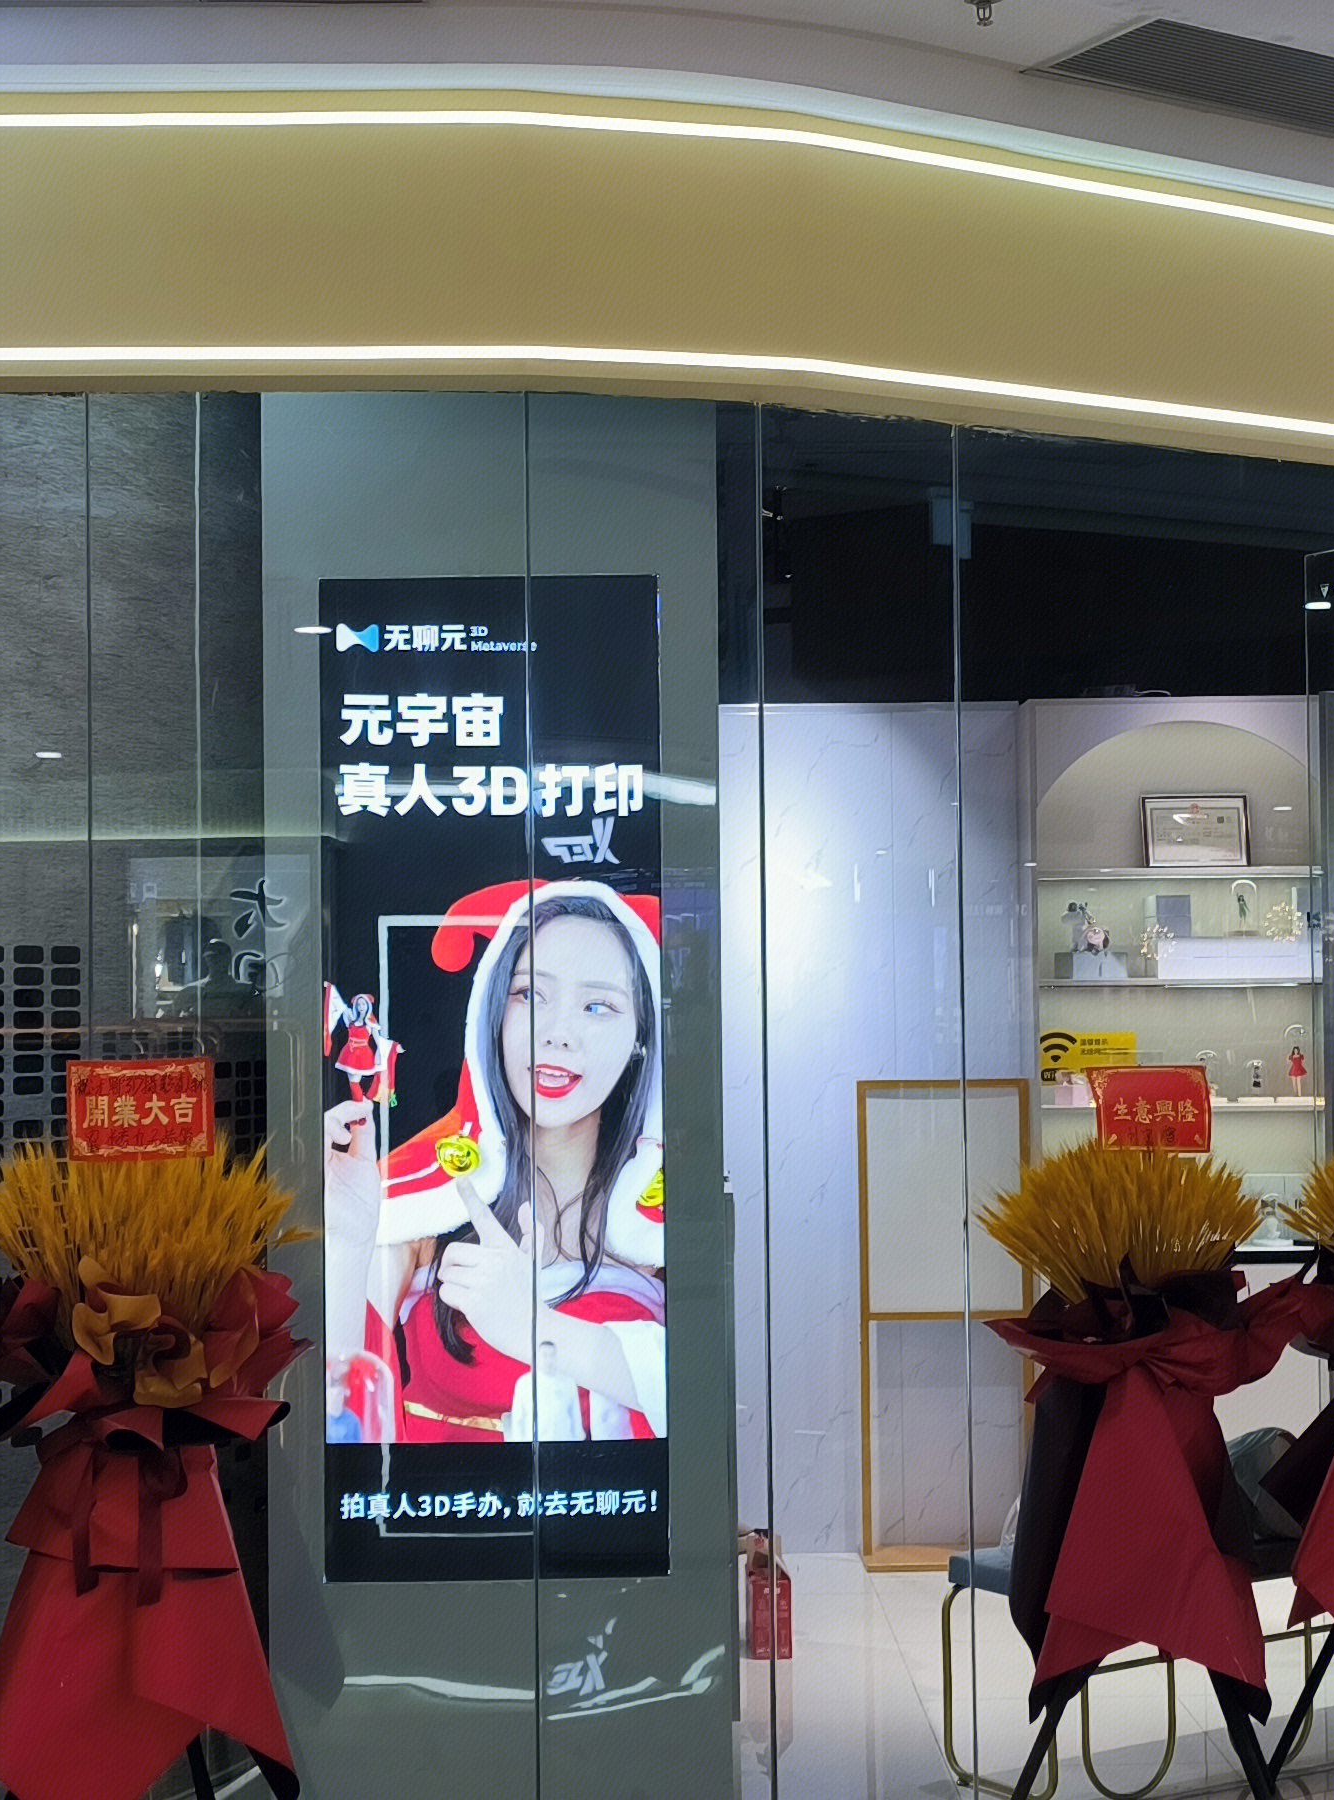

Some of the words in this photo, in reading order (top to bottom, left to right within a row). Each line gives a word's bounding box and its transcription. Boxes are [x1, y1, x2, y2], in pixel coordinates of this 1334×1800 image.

[383, 624, 467, 652] 无聊元
[469, 626, 488, 637] 3D
[338, 693, 503, 747] 元宇宙
[337, 762, 644, 818] 真人3D打印
[82, 1093, 197, 1129] 開業大吉
[1113, 1096, 1199, 1124] 生意興隆
